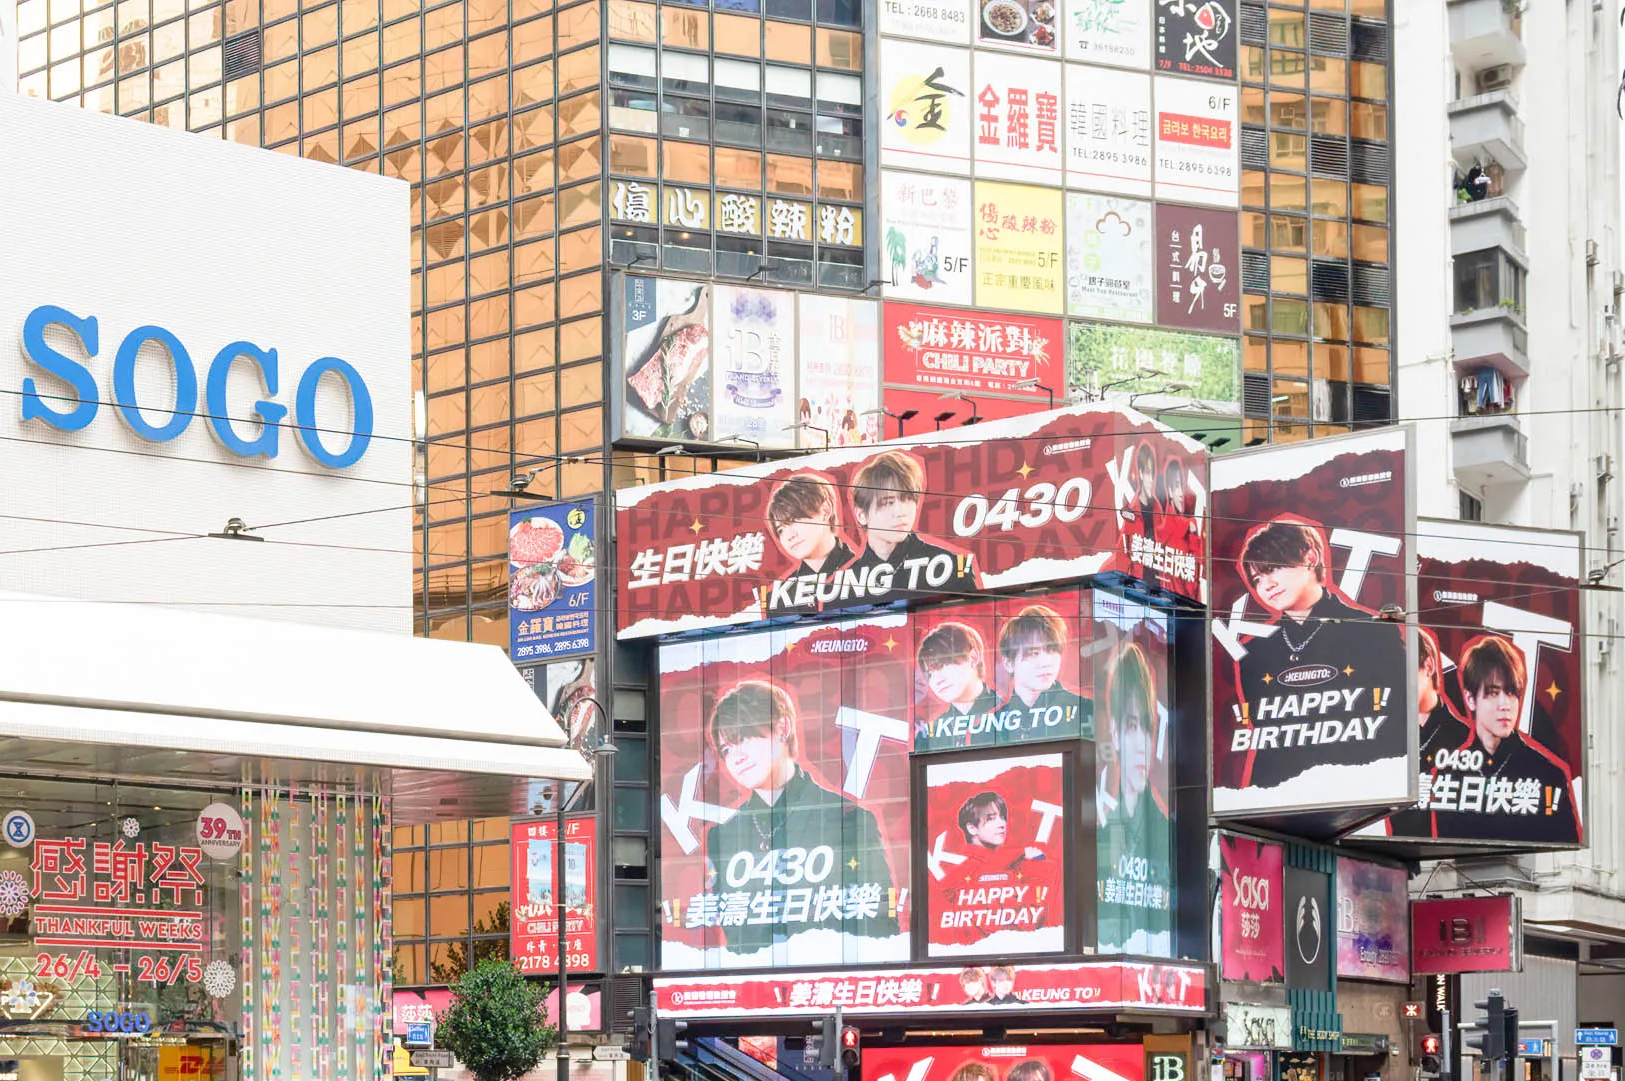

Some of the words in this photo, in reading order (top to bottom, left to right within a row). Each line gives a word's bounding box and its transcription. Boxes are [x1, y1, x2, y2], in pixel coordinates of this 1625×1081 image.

[1208, 96, 1231, 110] 6/F
[978, 83, 1058, 153] 金羅寶
[1122, 154, 1147, 167] 3986
[944, 255, 969, 273] 5/F
[1038, 252, 1059, 269] 5/F
[631, 310, 647, 321] 3F
[1223, 303, 1237, 318] 5F
[922, 318, 1033, 356] 麻辣派對
[922, 352, 970, 372] CHILI
[972, 356, 1031, 377] PARTY
[20, 304, 374, 469] SOGO
[952, 477, 1093, 537] 0430
[628, 531, 766, 590] 生日快樂
[1330, 528, 1403, 601] T
[770, 559, 894, 610] KEUNG
[568, 592, 589, 607] 6/F
[517, 616, 555, 636] 金羅寶
[517, 646, 534, 657] 2895
[554, 640, 572, 652] 2895
[572, 638, 590, 649] 6398
[1257, 687, 1364, 721] HAPPY
[935, 709, 1022, 739] KEUNG
[1230, 715, 1387, 753] BIRTHDAY
[834, 706, 909, 799] T
[1434, 748, 1483, 771] 0430
[200, 837, 242, 850] ANNIVERSARY
[30, 836, 205, 905] 感謝祭
[726, 846, 834, 888] 0430
[1118, 854, 1148, 881] 0430
[685, 883, 882, 929] 姜濤生日快樂
[958, 886, 1030, 906] HAPPY
[35, 916, 135, 937] THANKFUL
[139, 920, 203, 940] WEEKS
[940, 906, 1045, 929] BIRTHDAY
[1241, 911, 1261, 939] 莎莎
[37, 949, 101, 983] 26/4
[138, 953, 203, 986] 26/5
[520, 955, 551, 970] 2178
[789, 979, 923, 1007] 姜濤生日快樂
[1021, 988, 1071, 1001] KEUNG
[1437, 986, 1446, 1011] WALK
[88, 1011, 151, 1033] SOGO
